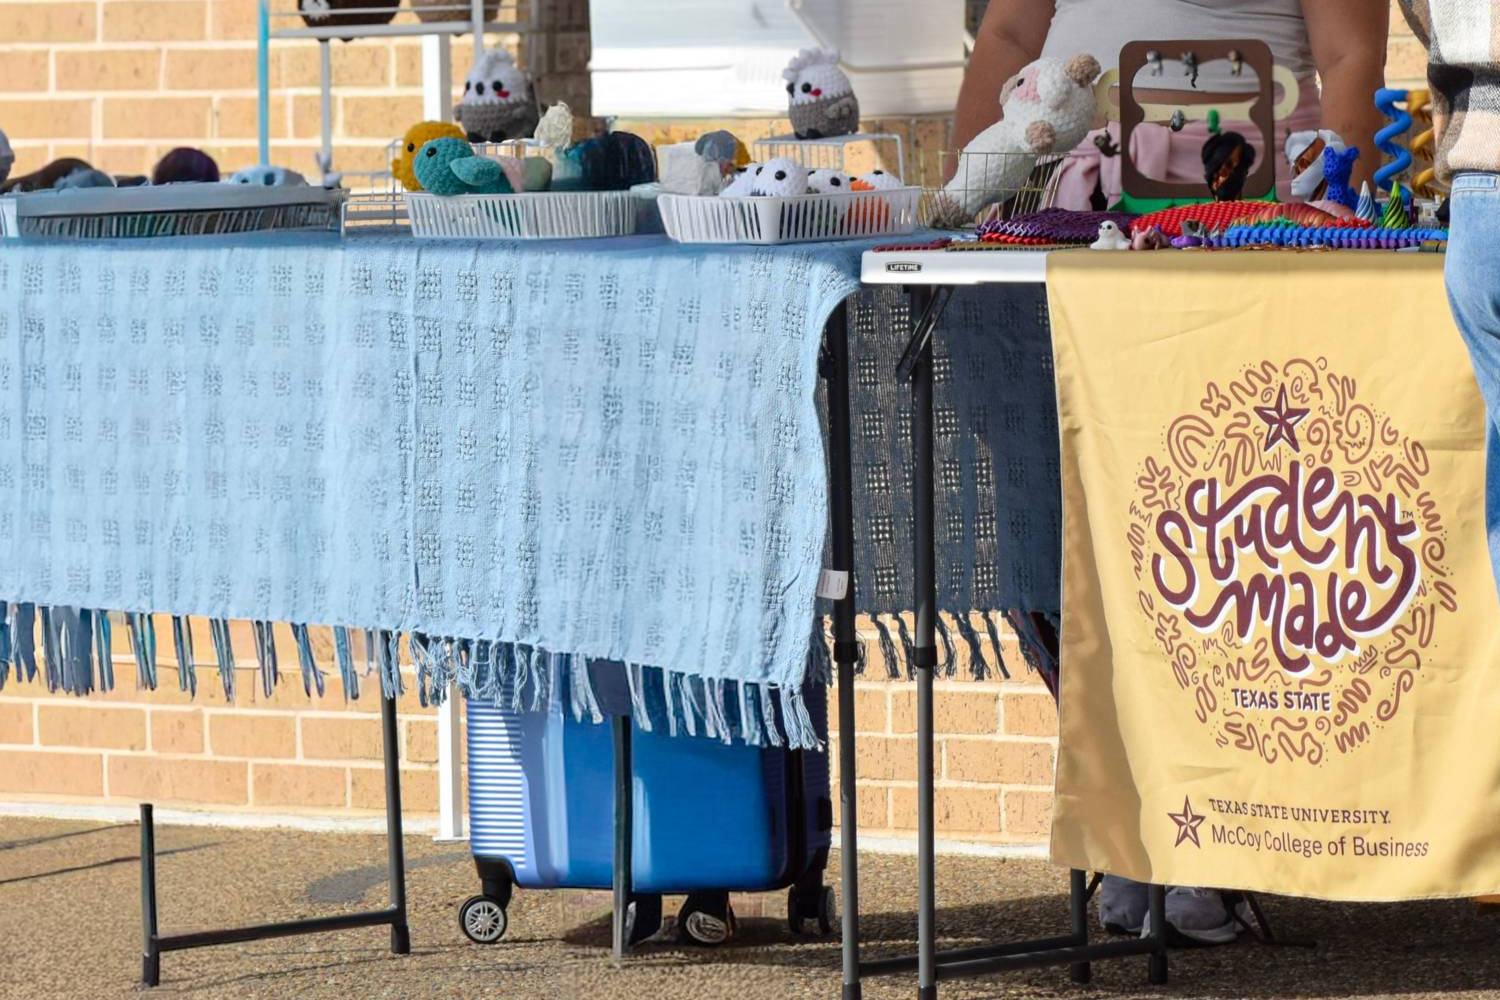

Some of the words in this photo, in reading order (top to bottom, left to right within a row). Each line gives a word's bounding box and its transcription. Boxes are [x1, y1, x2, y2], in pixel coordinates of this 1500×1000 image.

[1151, 460, 1418, 605] Student
[1184, 571, 1392, 673] made
[1231, 688, 1279, 710] TEXAS
[1283, 690, 1331, 711] STATE
[1208, 798, 1249, 816] TEXAS
[1250, 803, 1289, 820] STATE
[1211, 823, 1262, 852] McCoy
[1264, 830, 1323, 859] College
[1327, 835, 1347, 856] of
[1353, 836, 1429, 857] Business
